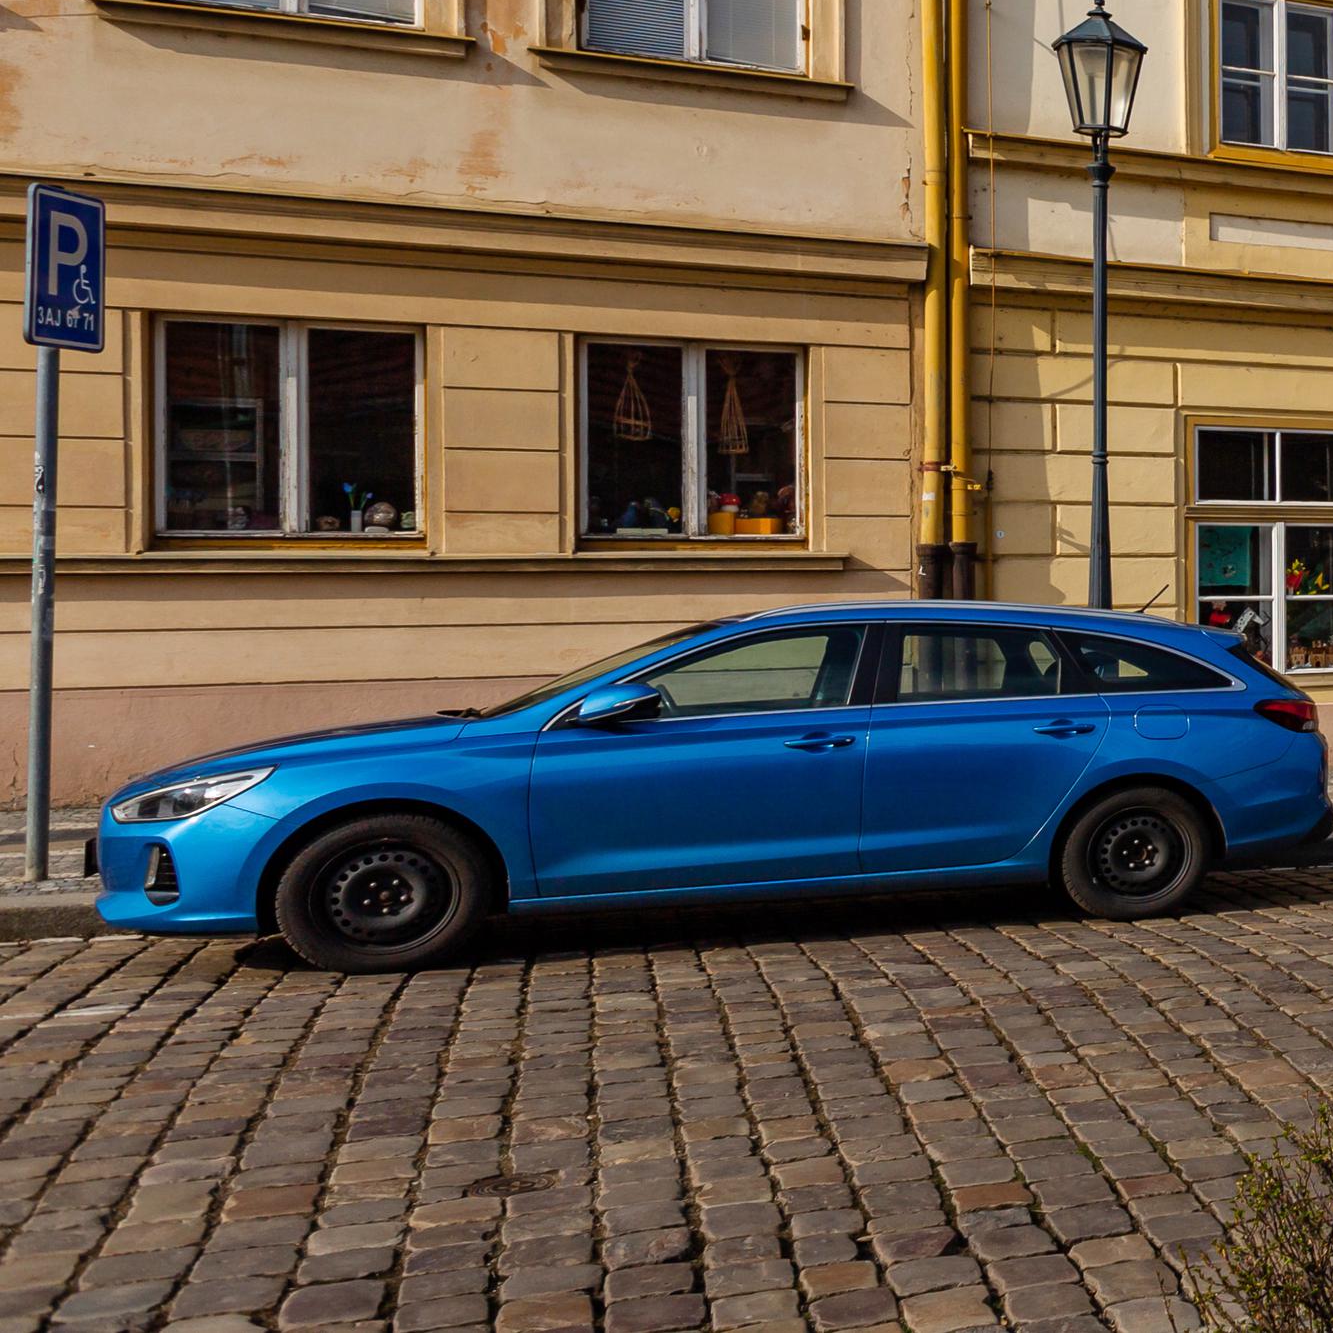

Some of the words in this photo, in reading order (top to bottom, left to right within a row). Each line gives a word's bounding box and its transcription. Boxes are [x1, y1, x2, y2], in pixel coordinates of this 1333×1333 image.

[48, 210, 88, 296] P
[37, 306, 61, 327] 3AJ
[83, 313, 94, 332] 71
